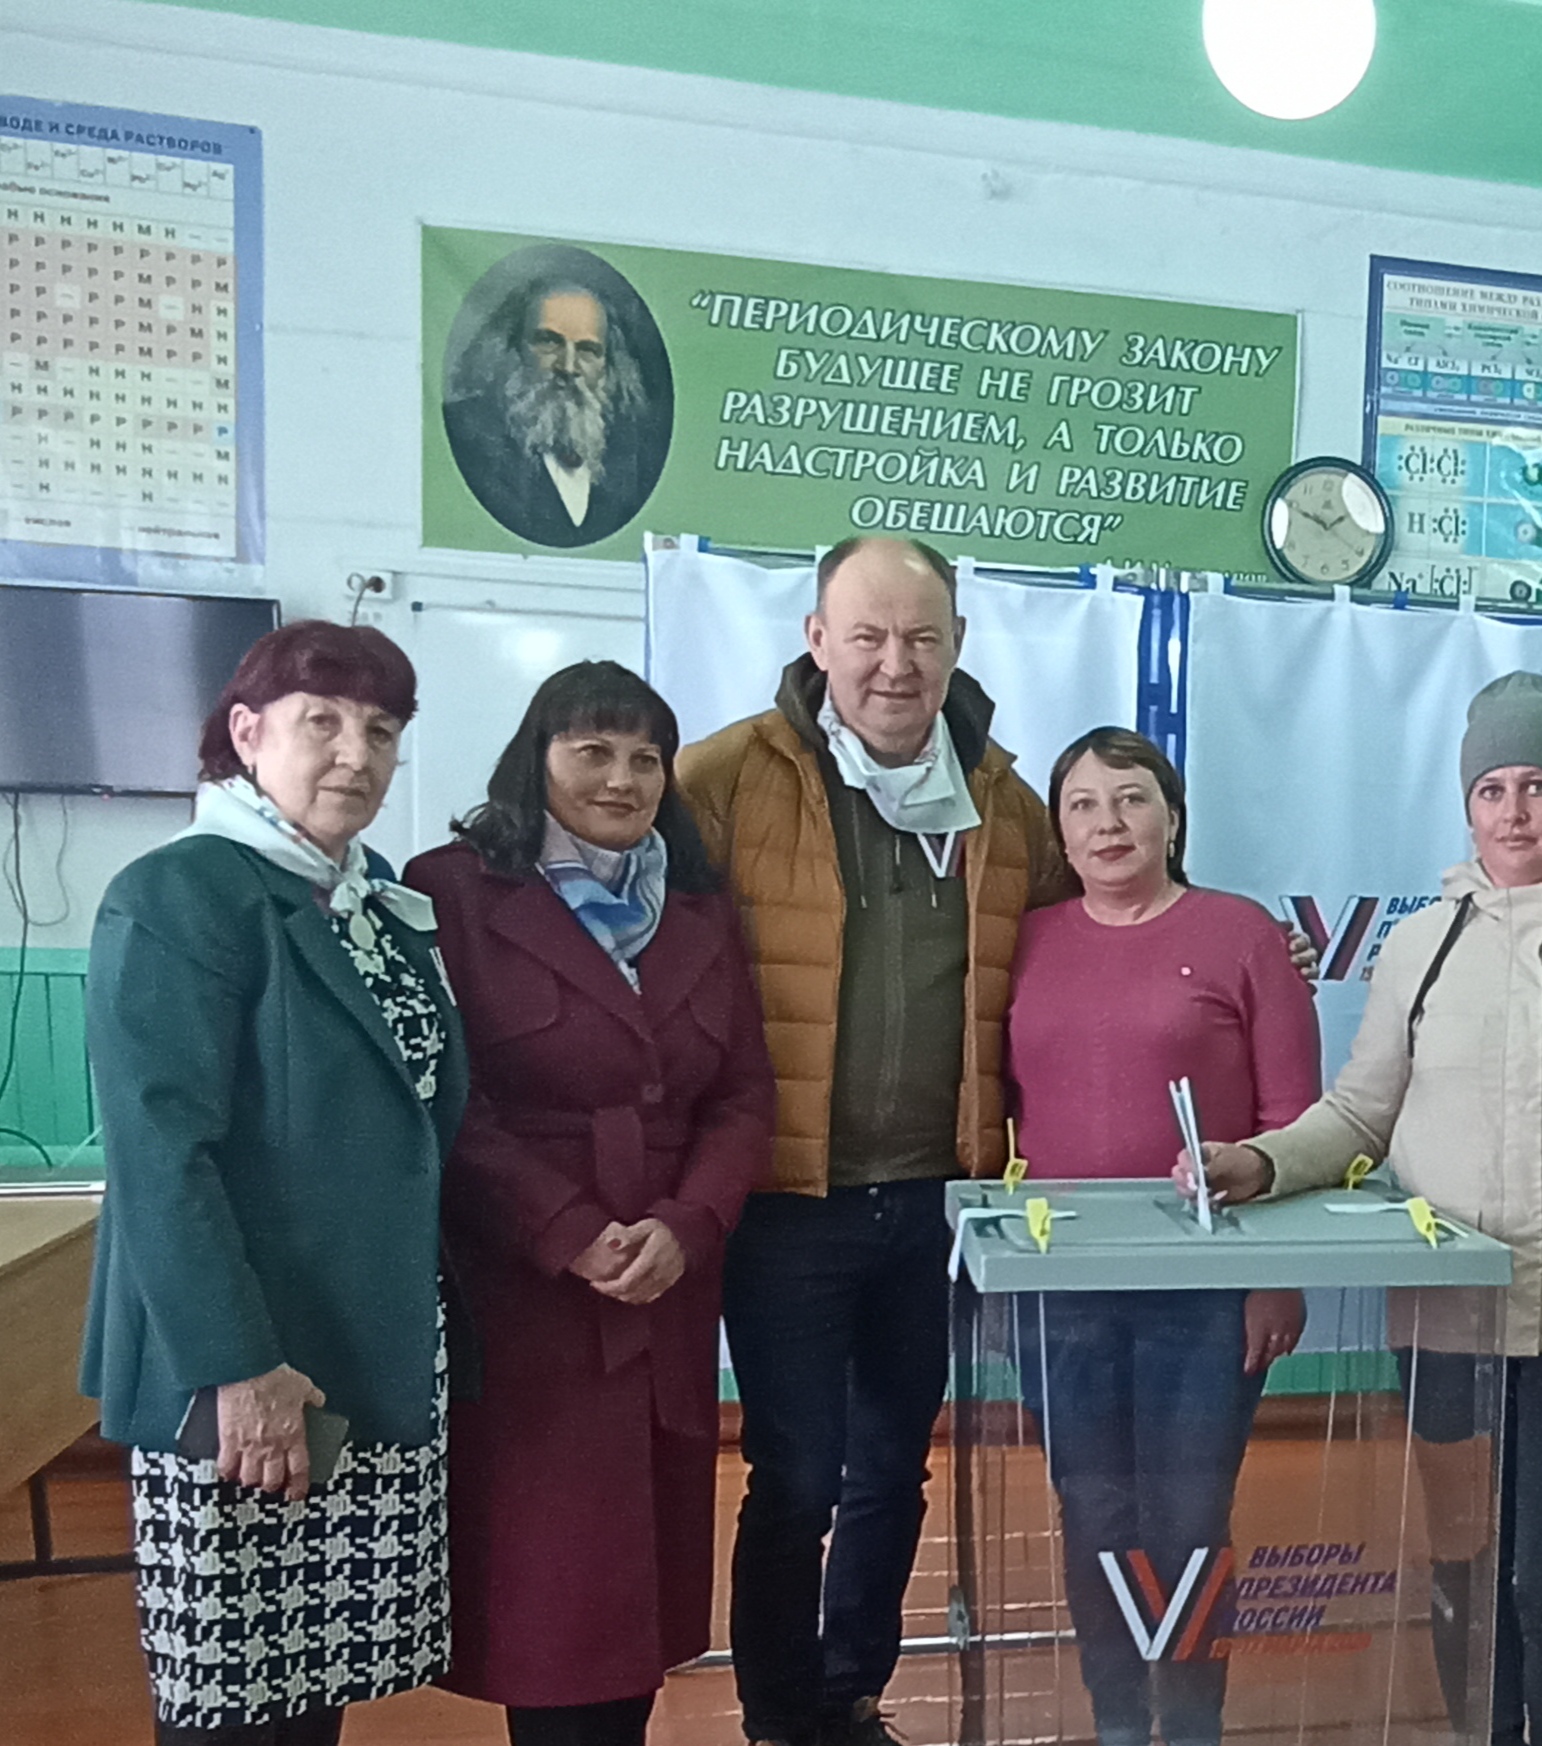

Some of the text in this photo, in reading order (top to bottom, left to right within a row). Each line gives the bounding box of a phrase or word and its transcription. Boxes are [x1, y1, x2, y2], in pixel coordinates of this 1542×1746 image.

[48, 121, 60, 134] И
[65, 123, 120, 142] СРЕДА
[124, 130, 222, 155] РАСТВОРОВ
[1121, 334, 1280, 376] ЗАКОНУ
[776, 348, 1201, 414] БУДУЩЕЕ НЕ ГРОЗИТ
[721, 390, 1244, 464] РАЗРУШЕНИЕМ, А ТОЛЬКО
[716, 439, 1249, 510] НАДСТРОЙКА И РАЗВИТИЕ
[1249, 1542, 1366, 1568] ВЫБОРЫ
[1231, 1570, 1397, 1600] ПРЕЗИДЕНТА
[1230, 1604, 1327, 1632] ОССИИ
